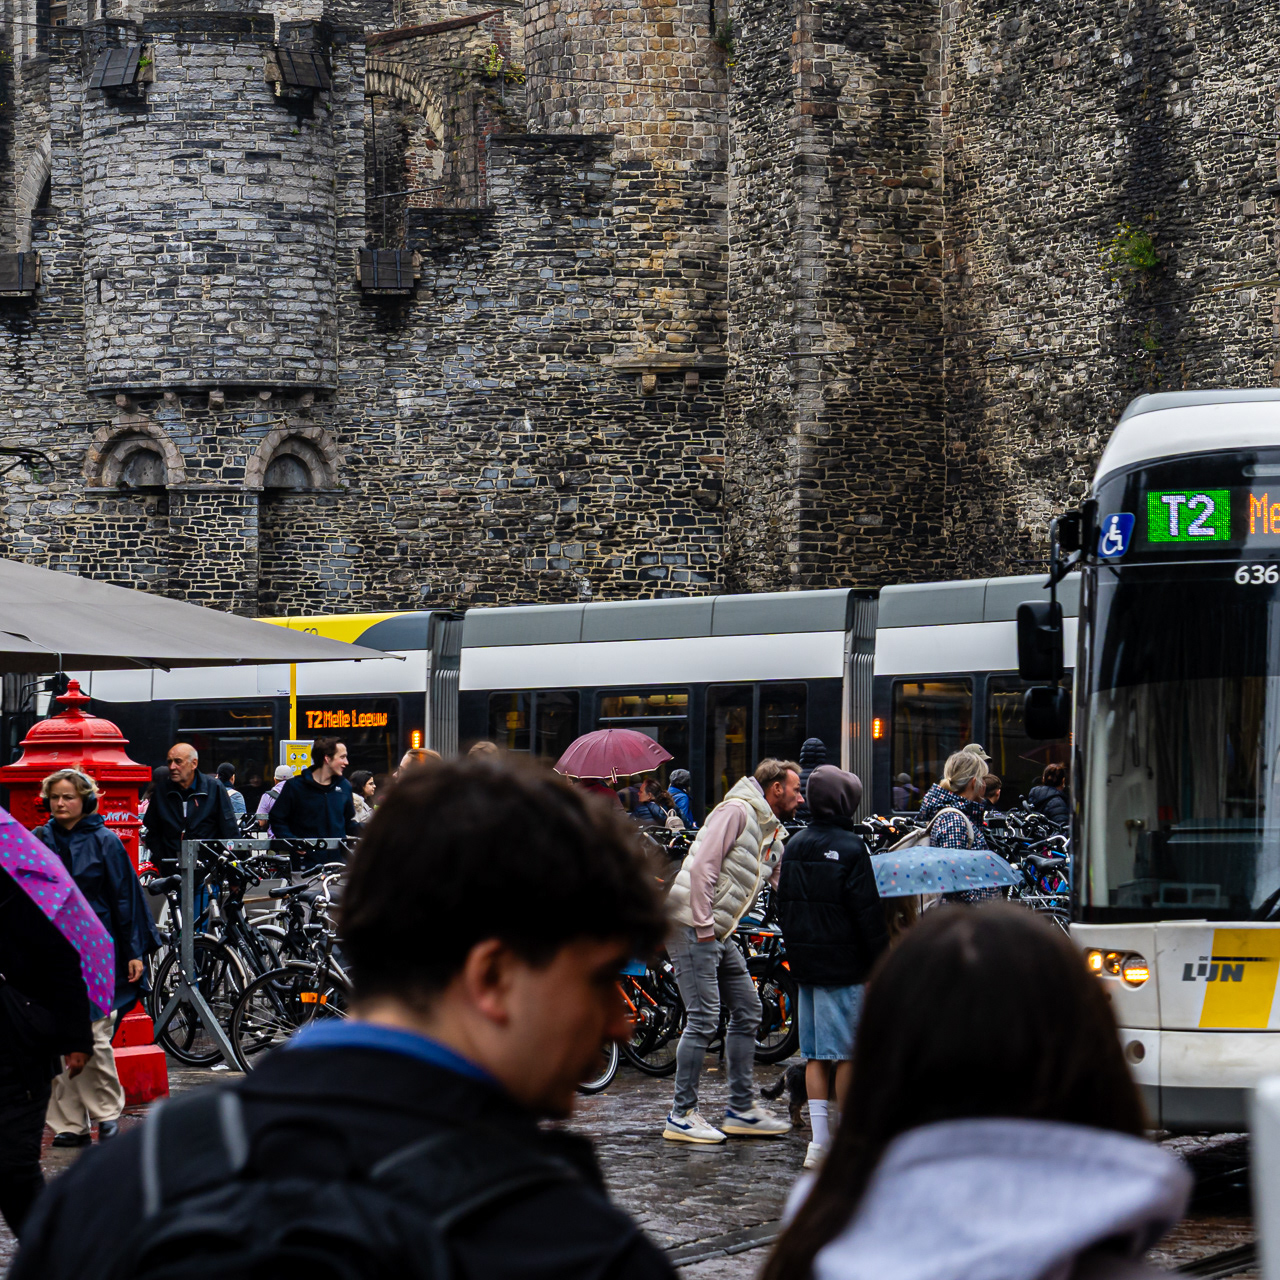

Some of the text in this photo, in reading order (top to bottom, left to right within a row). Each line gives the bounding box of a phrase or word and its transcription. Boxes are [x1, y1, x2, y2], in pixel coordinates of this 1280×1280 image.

[1161, 493, 1216, 538] T2
[305, 709, 387, 729] T2 Melle Leeuw
